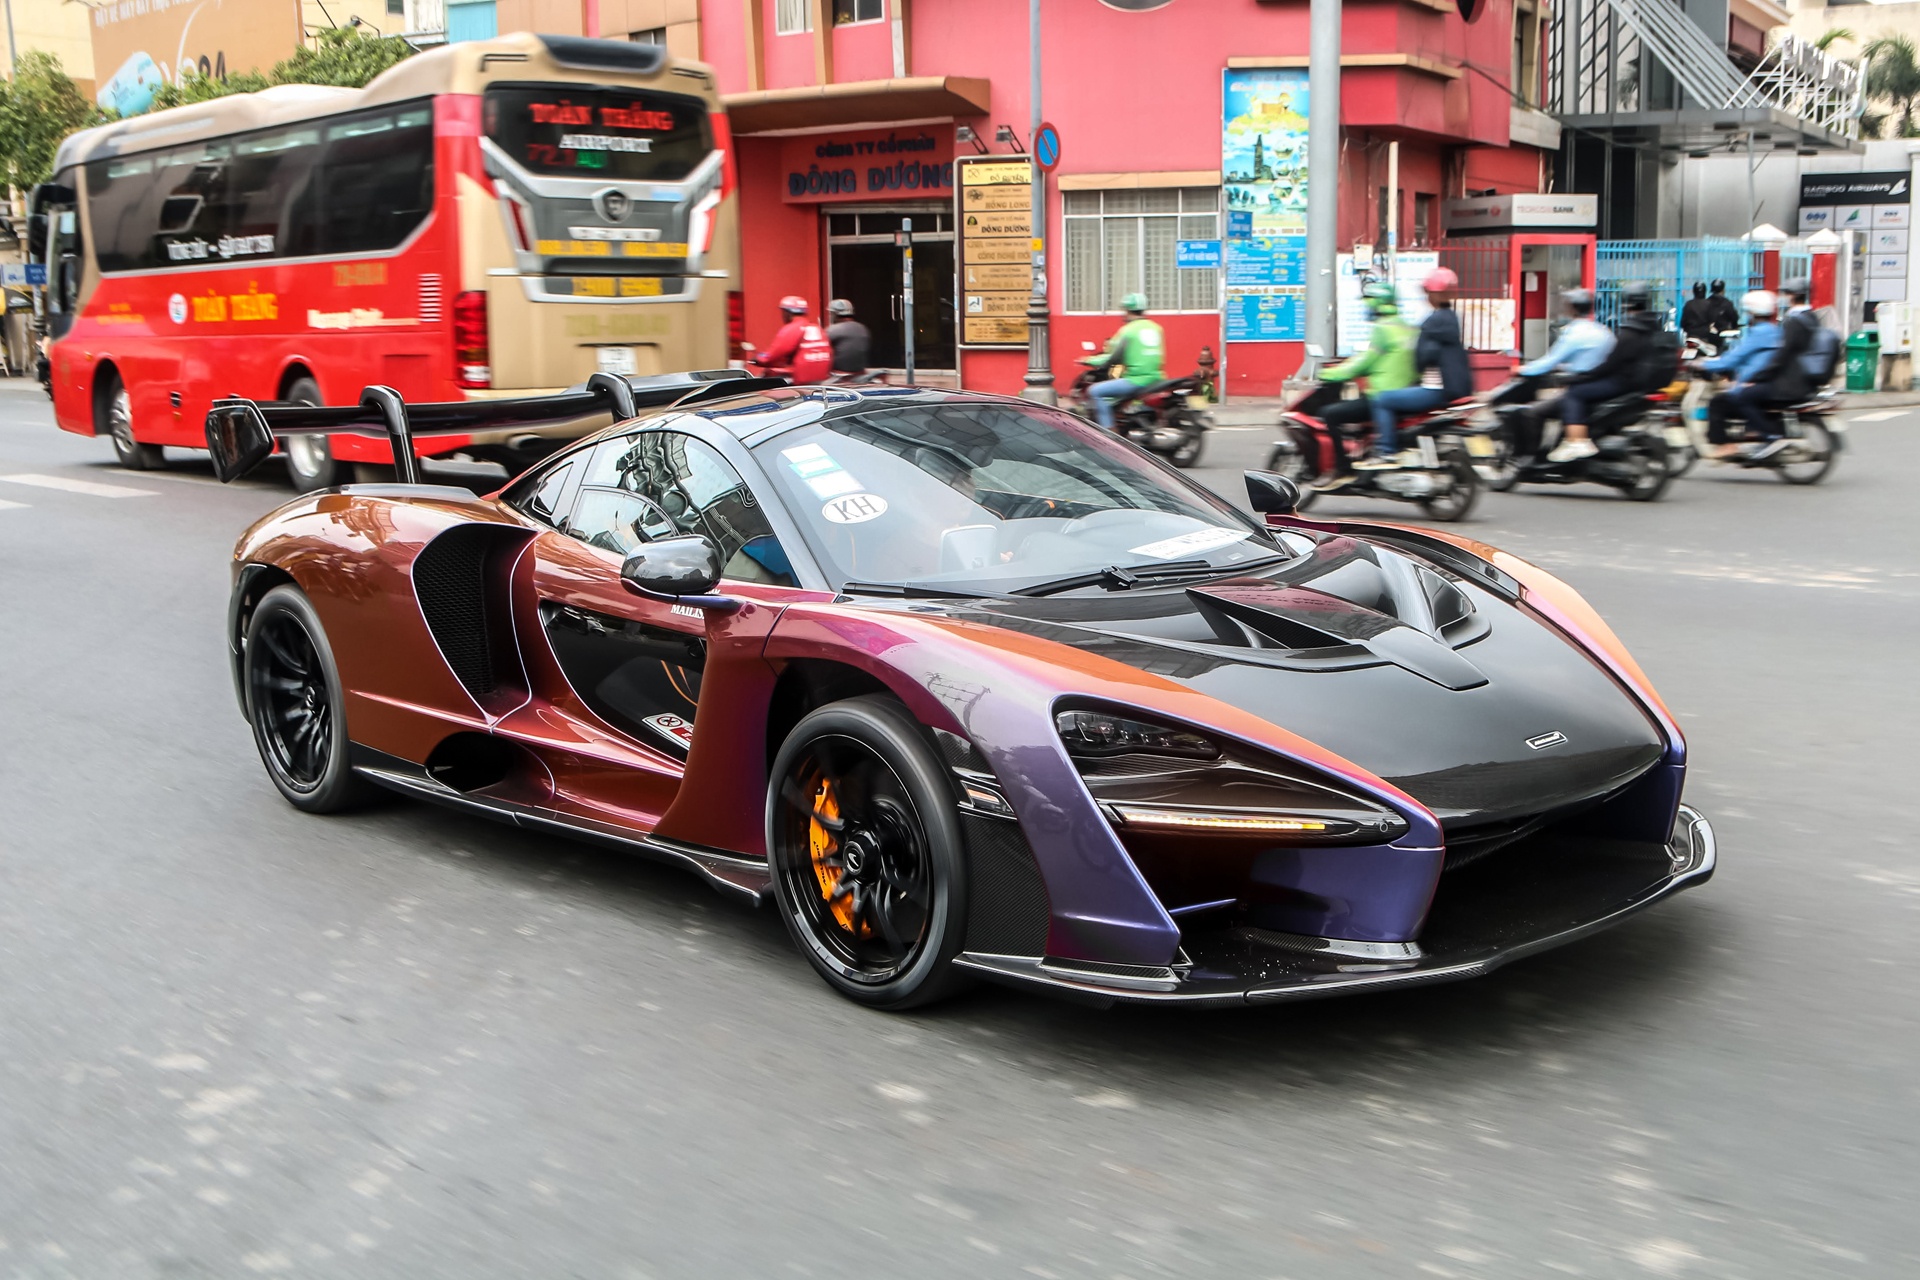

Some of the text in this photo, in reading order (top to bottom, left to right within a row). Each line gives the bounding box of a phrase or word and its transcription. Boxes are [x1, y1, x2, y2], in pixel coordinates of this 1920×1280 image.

[559, 134, 653, 152] AIRPORT
[856, 142, 875, 154] TY
[788, 161, 954, 196] ĐÔNG DƯƠNG
[1803, 182, 1891, 194] BAMBOO AIRWAYS
[830, 496, 880, 521] KH
[671, 604, 706, 620] MAILIS
